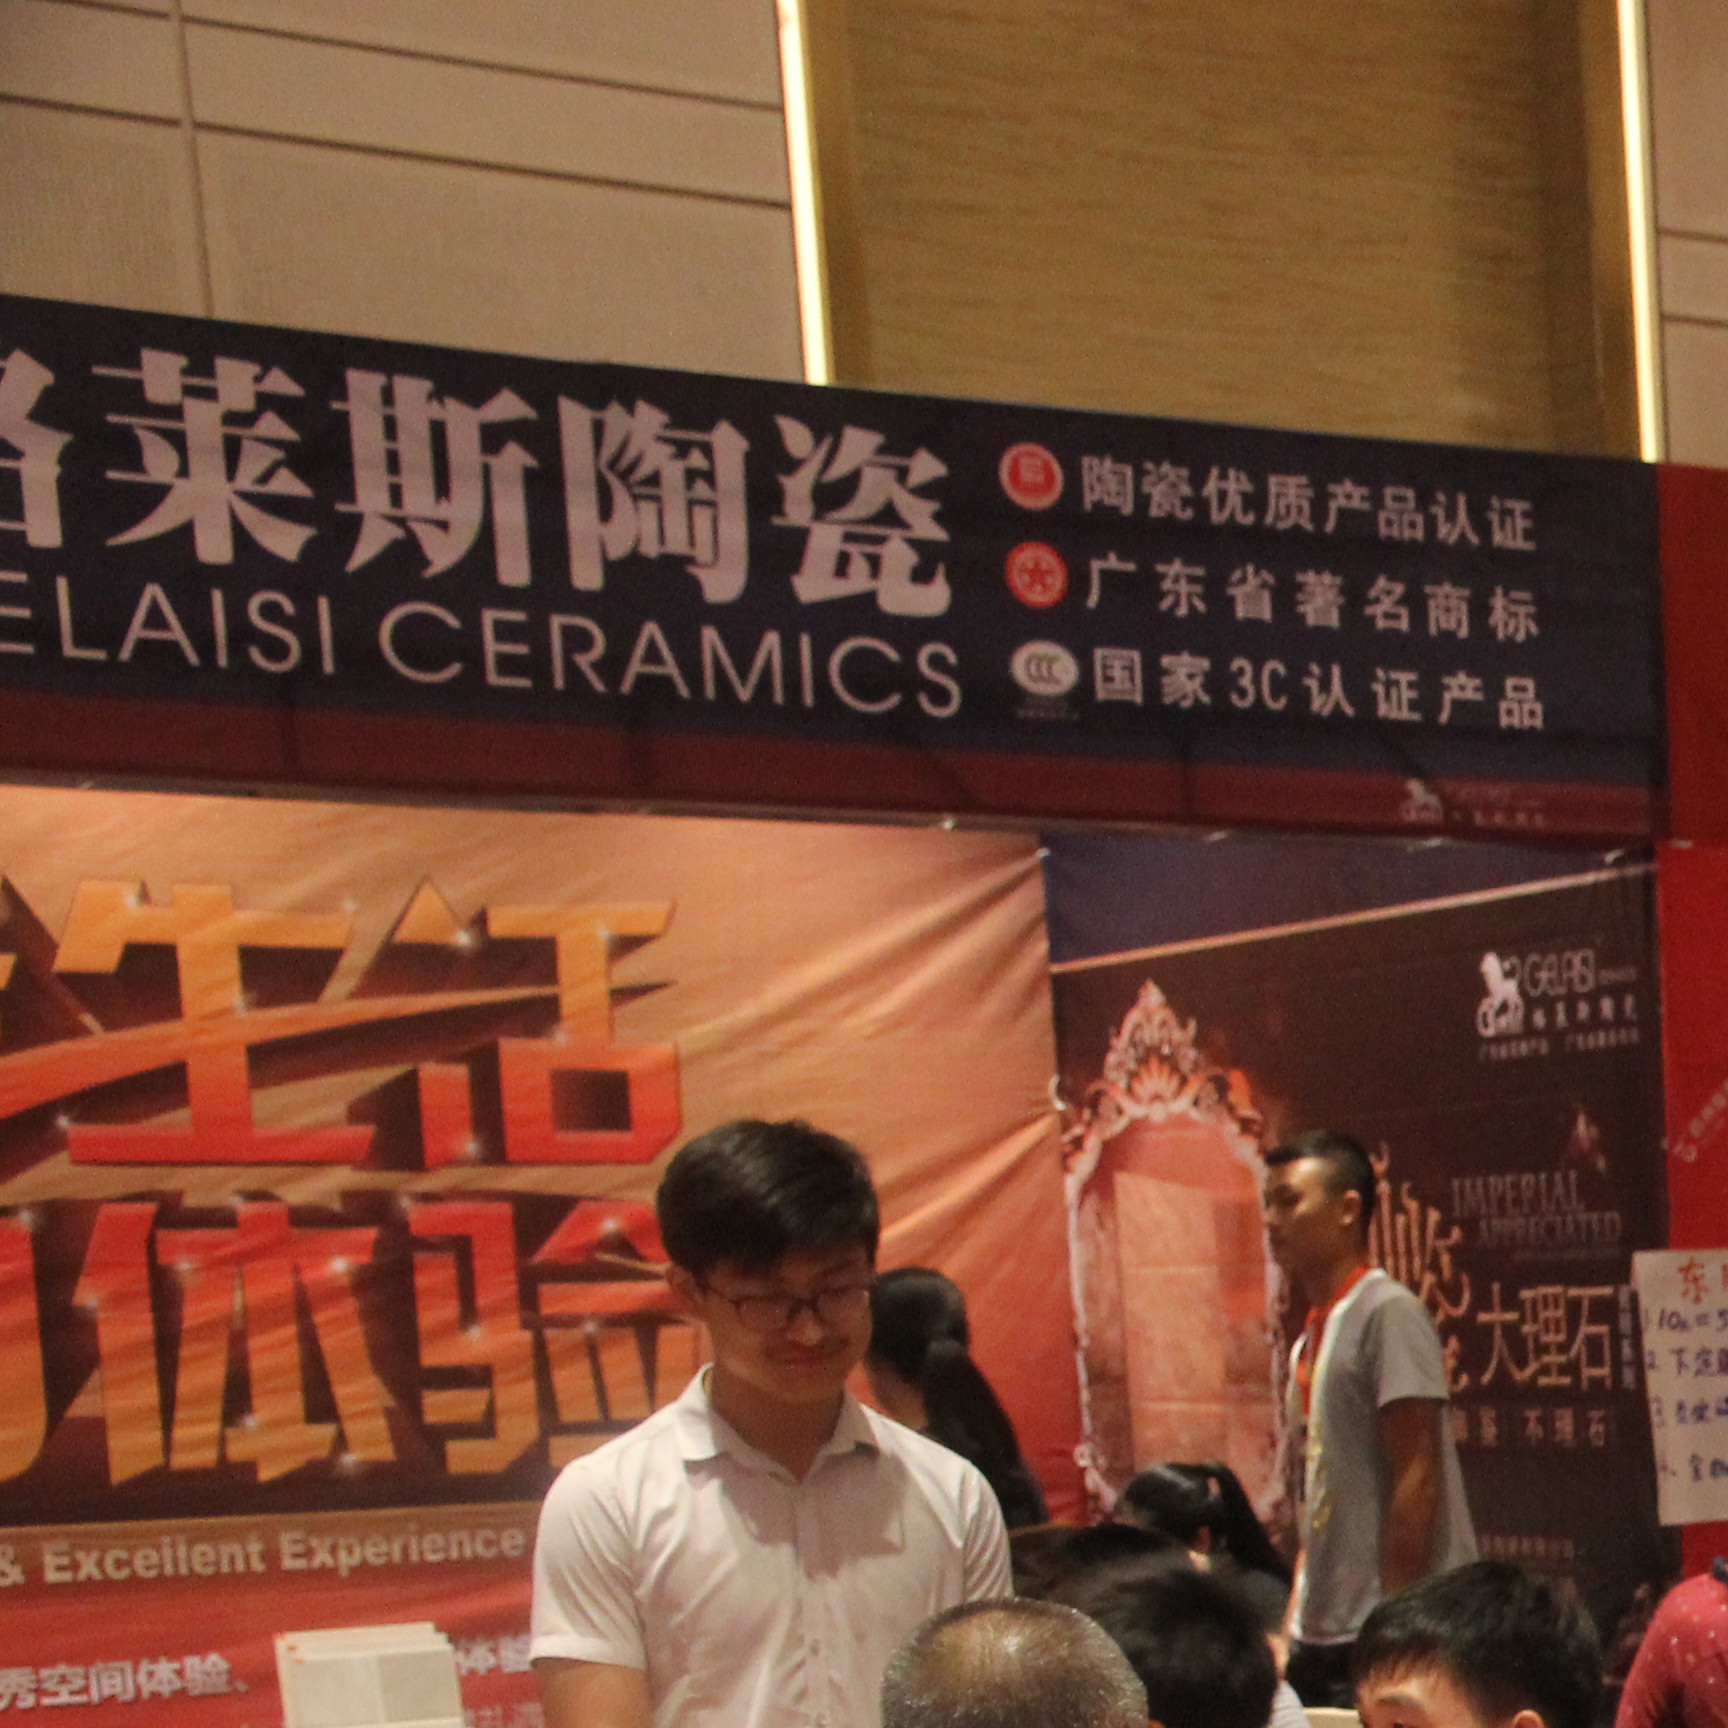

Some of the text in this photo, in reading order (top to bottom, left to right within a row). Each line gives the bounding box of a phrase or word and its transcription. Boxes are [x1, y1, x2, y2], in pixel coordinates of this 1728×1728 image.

[1080, 454, 1537, 552] 陶瓷优质产品认证
[1085, 551, 1540, 644] 广东省著名商标
[378, 600, 963, 719] CERAMICS
[1093, 646, 1545, 731] 国家3C认证产品
[1476, 1283, 1614, 1391] 大理石
[43, 1532, 266, 1585] Excellent
[280, 1523, 525, 1578] Experience
